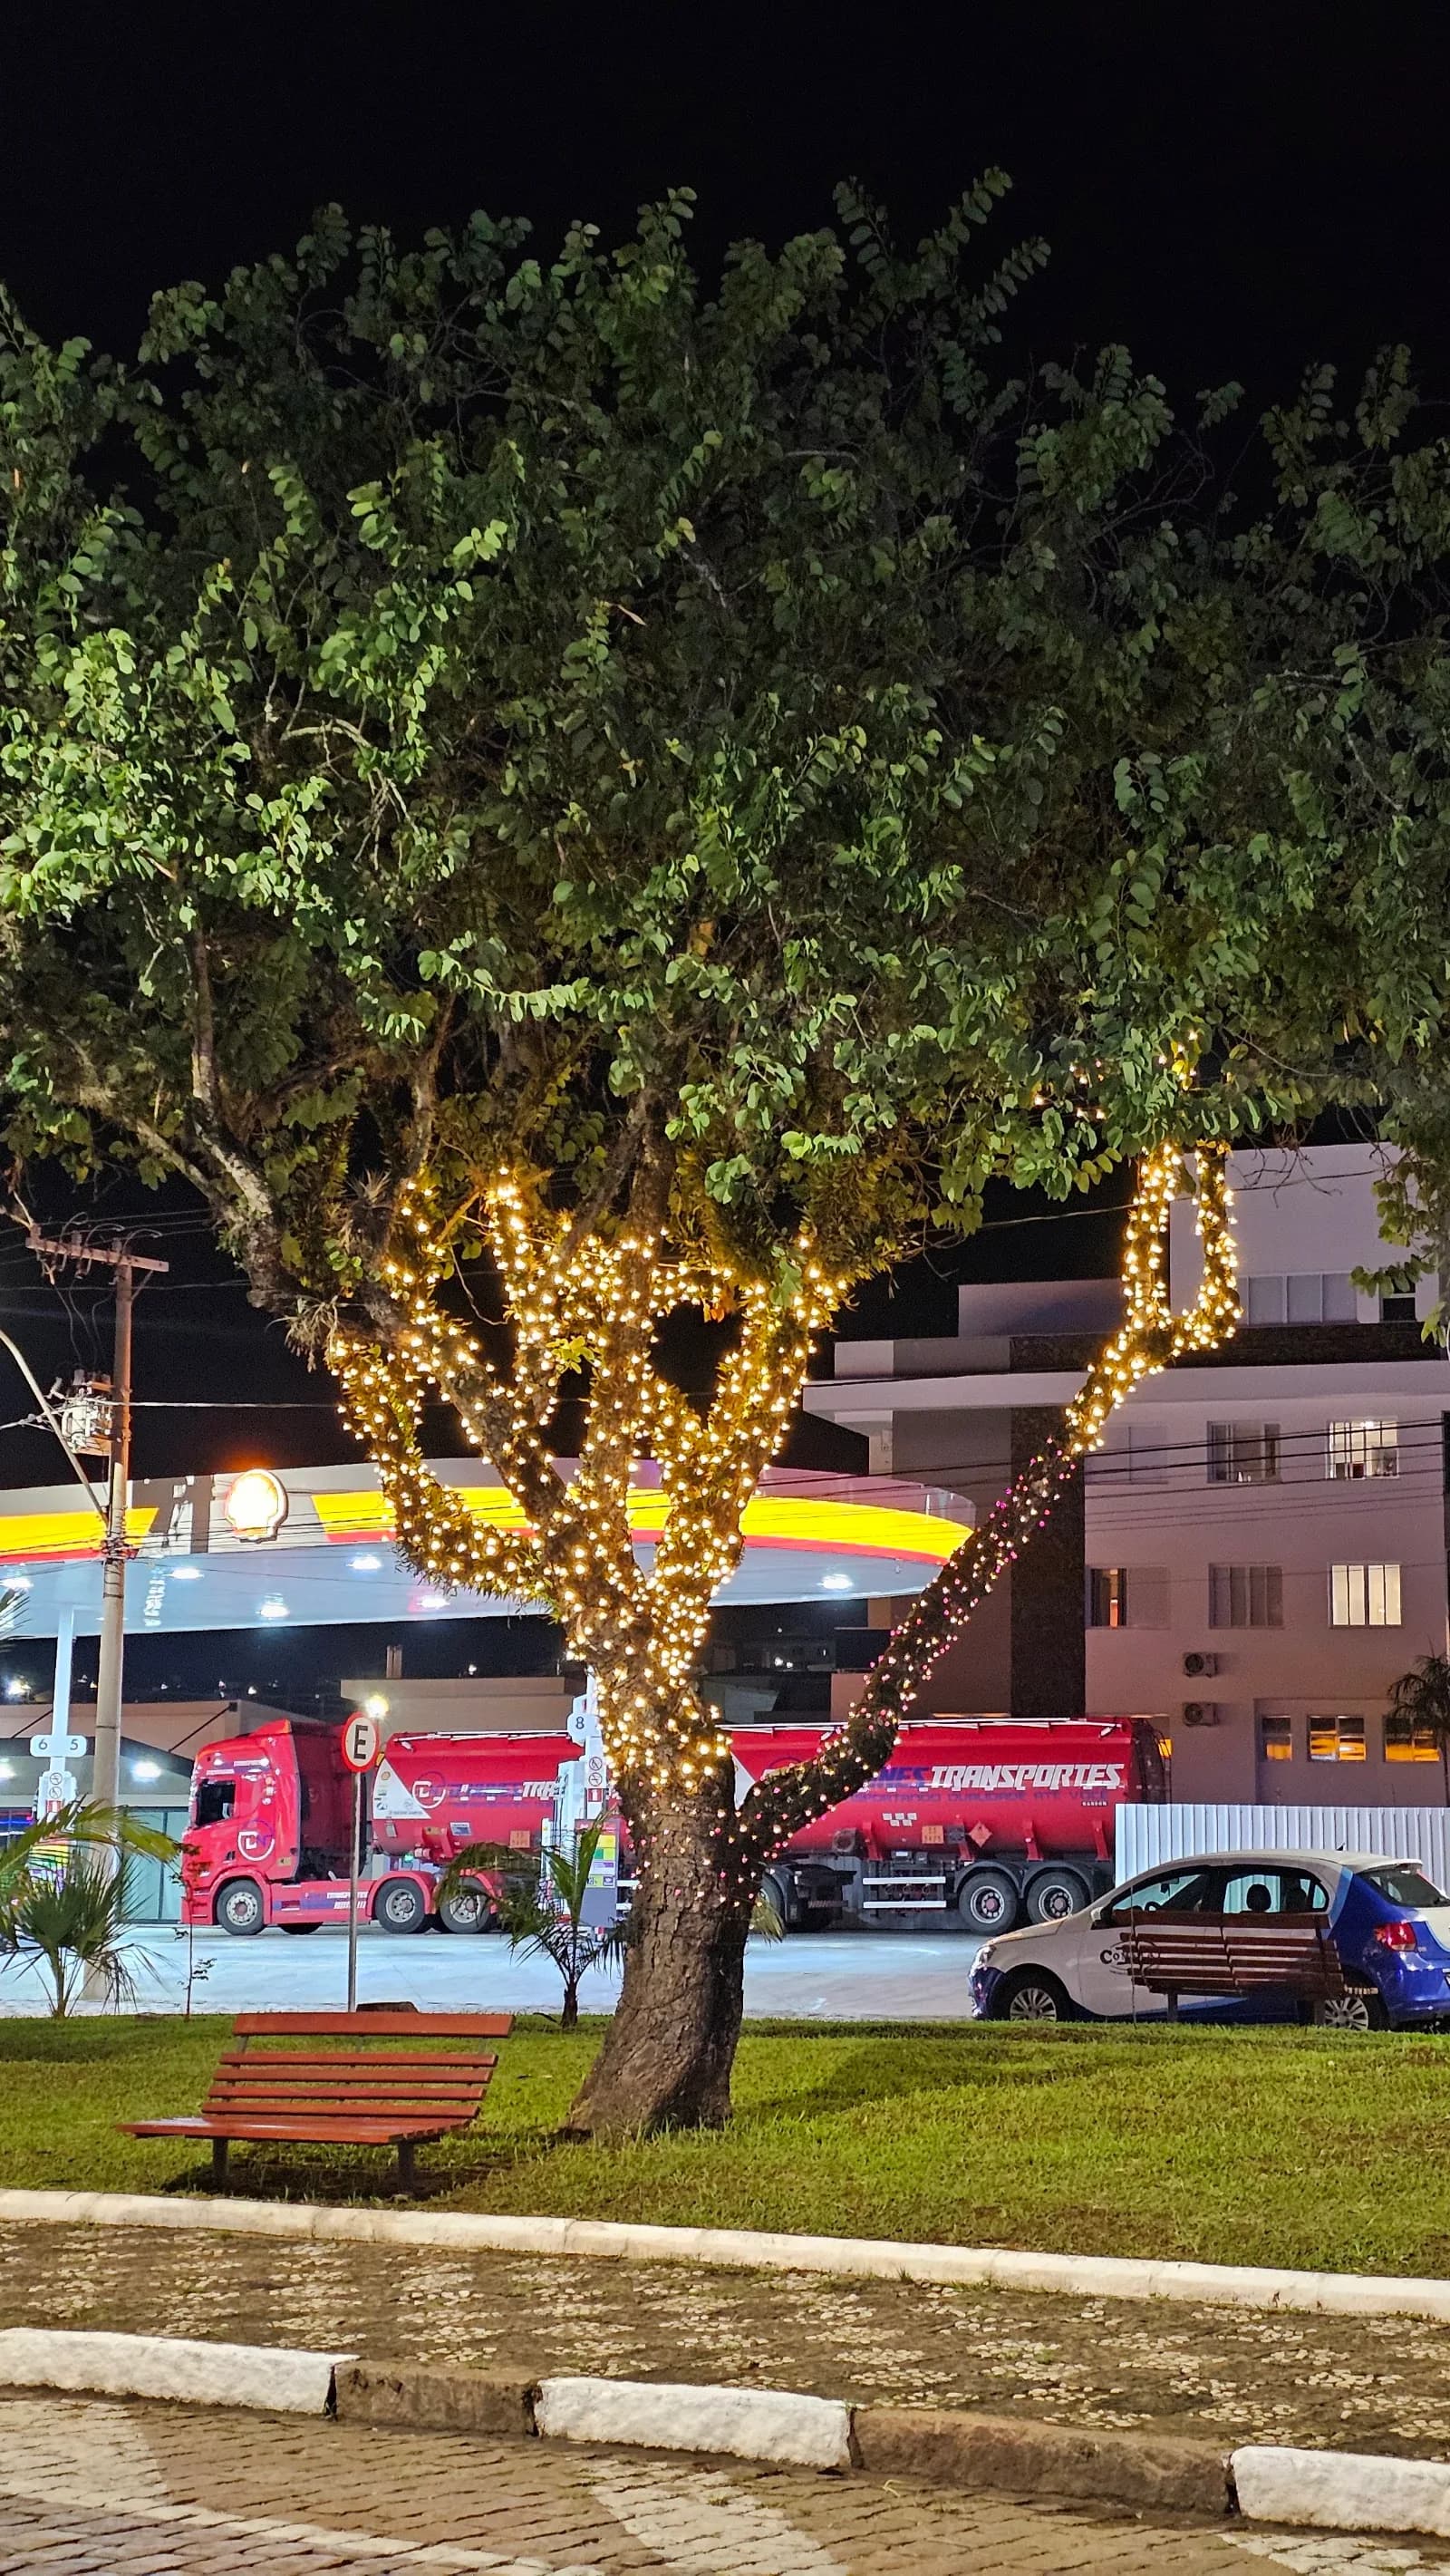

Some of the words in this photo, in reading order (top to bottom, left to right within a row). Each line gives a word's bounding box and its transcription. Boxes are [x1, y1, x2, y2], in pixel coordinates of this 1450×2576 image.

[575, 1716, 585, 1730] 8
[38, 1738, 48, 1750] 6
[70, 1738, 79, 1750] 5
[353, 1725, 370, 1759] E
[931, 1763, 1125, 1789] TRANSPORTES
